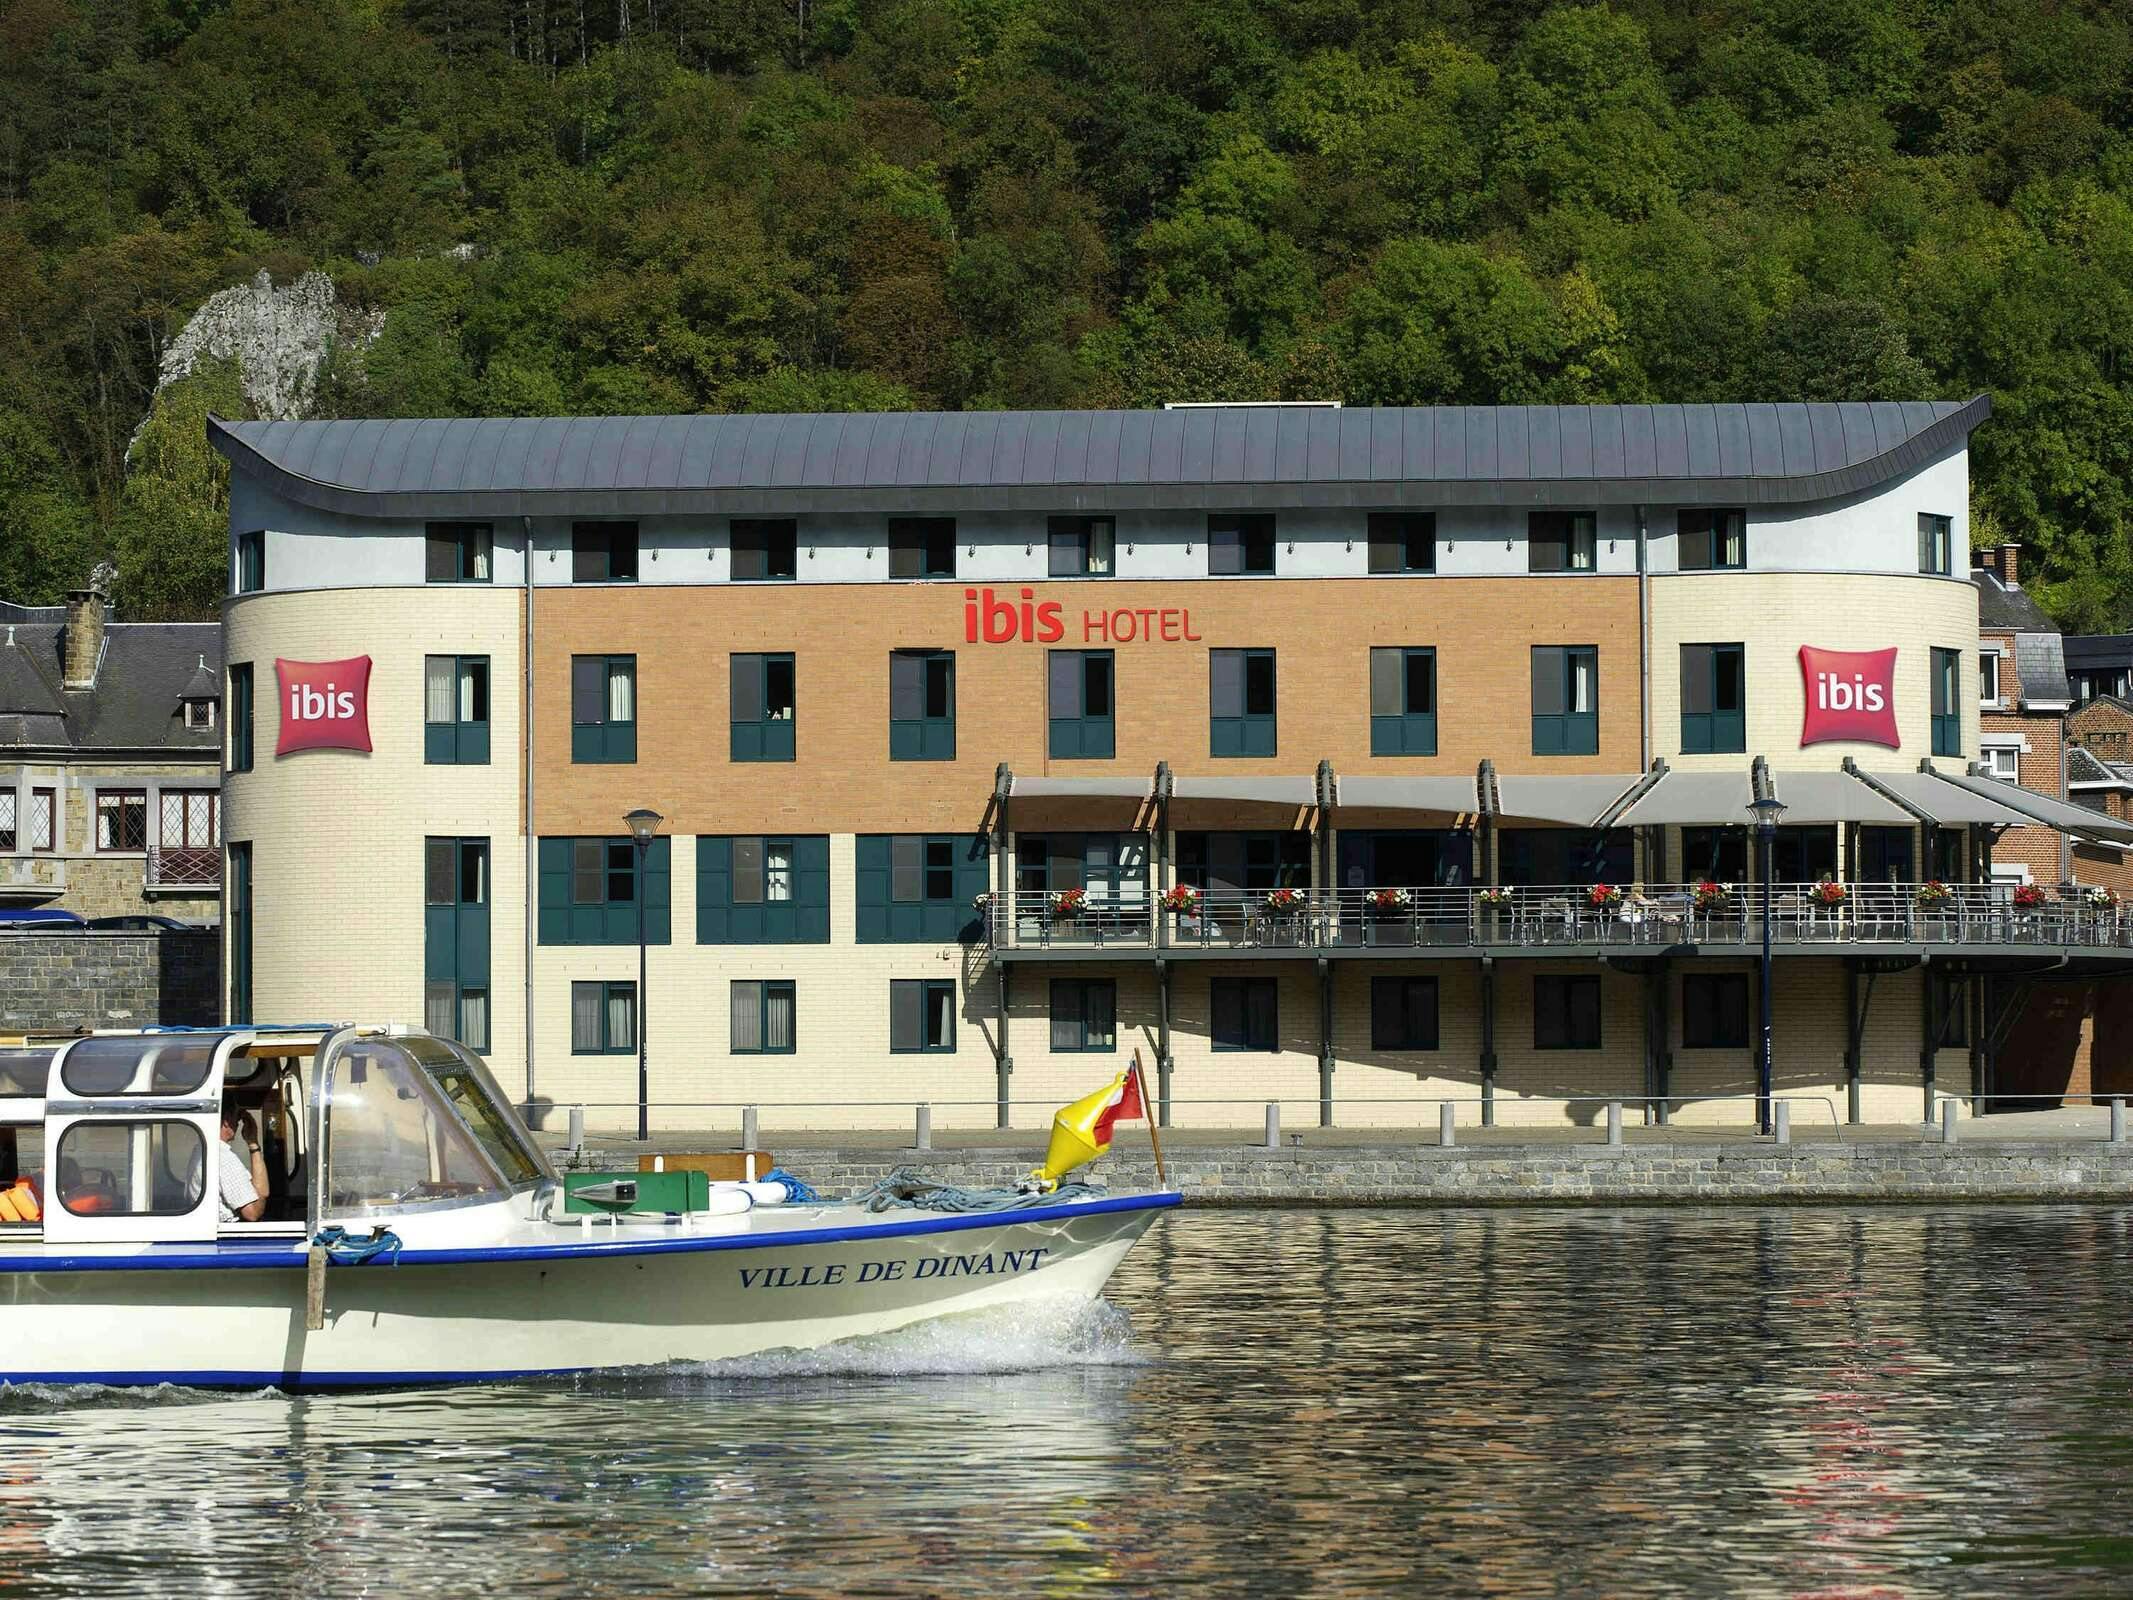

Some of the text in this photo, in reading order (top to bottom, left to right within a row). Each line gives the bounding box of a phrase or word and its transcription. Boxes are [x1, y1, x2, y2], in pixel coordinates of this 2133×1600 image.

[966, 588, 1202, 643] ibis HOTEL
[291, 683, 356, 720] ibis
[1818, 672, 1885, 712] ibis
[739, 1248, 1049, 1289] VILLE DE DINANT
